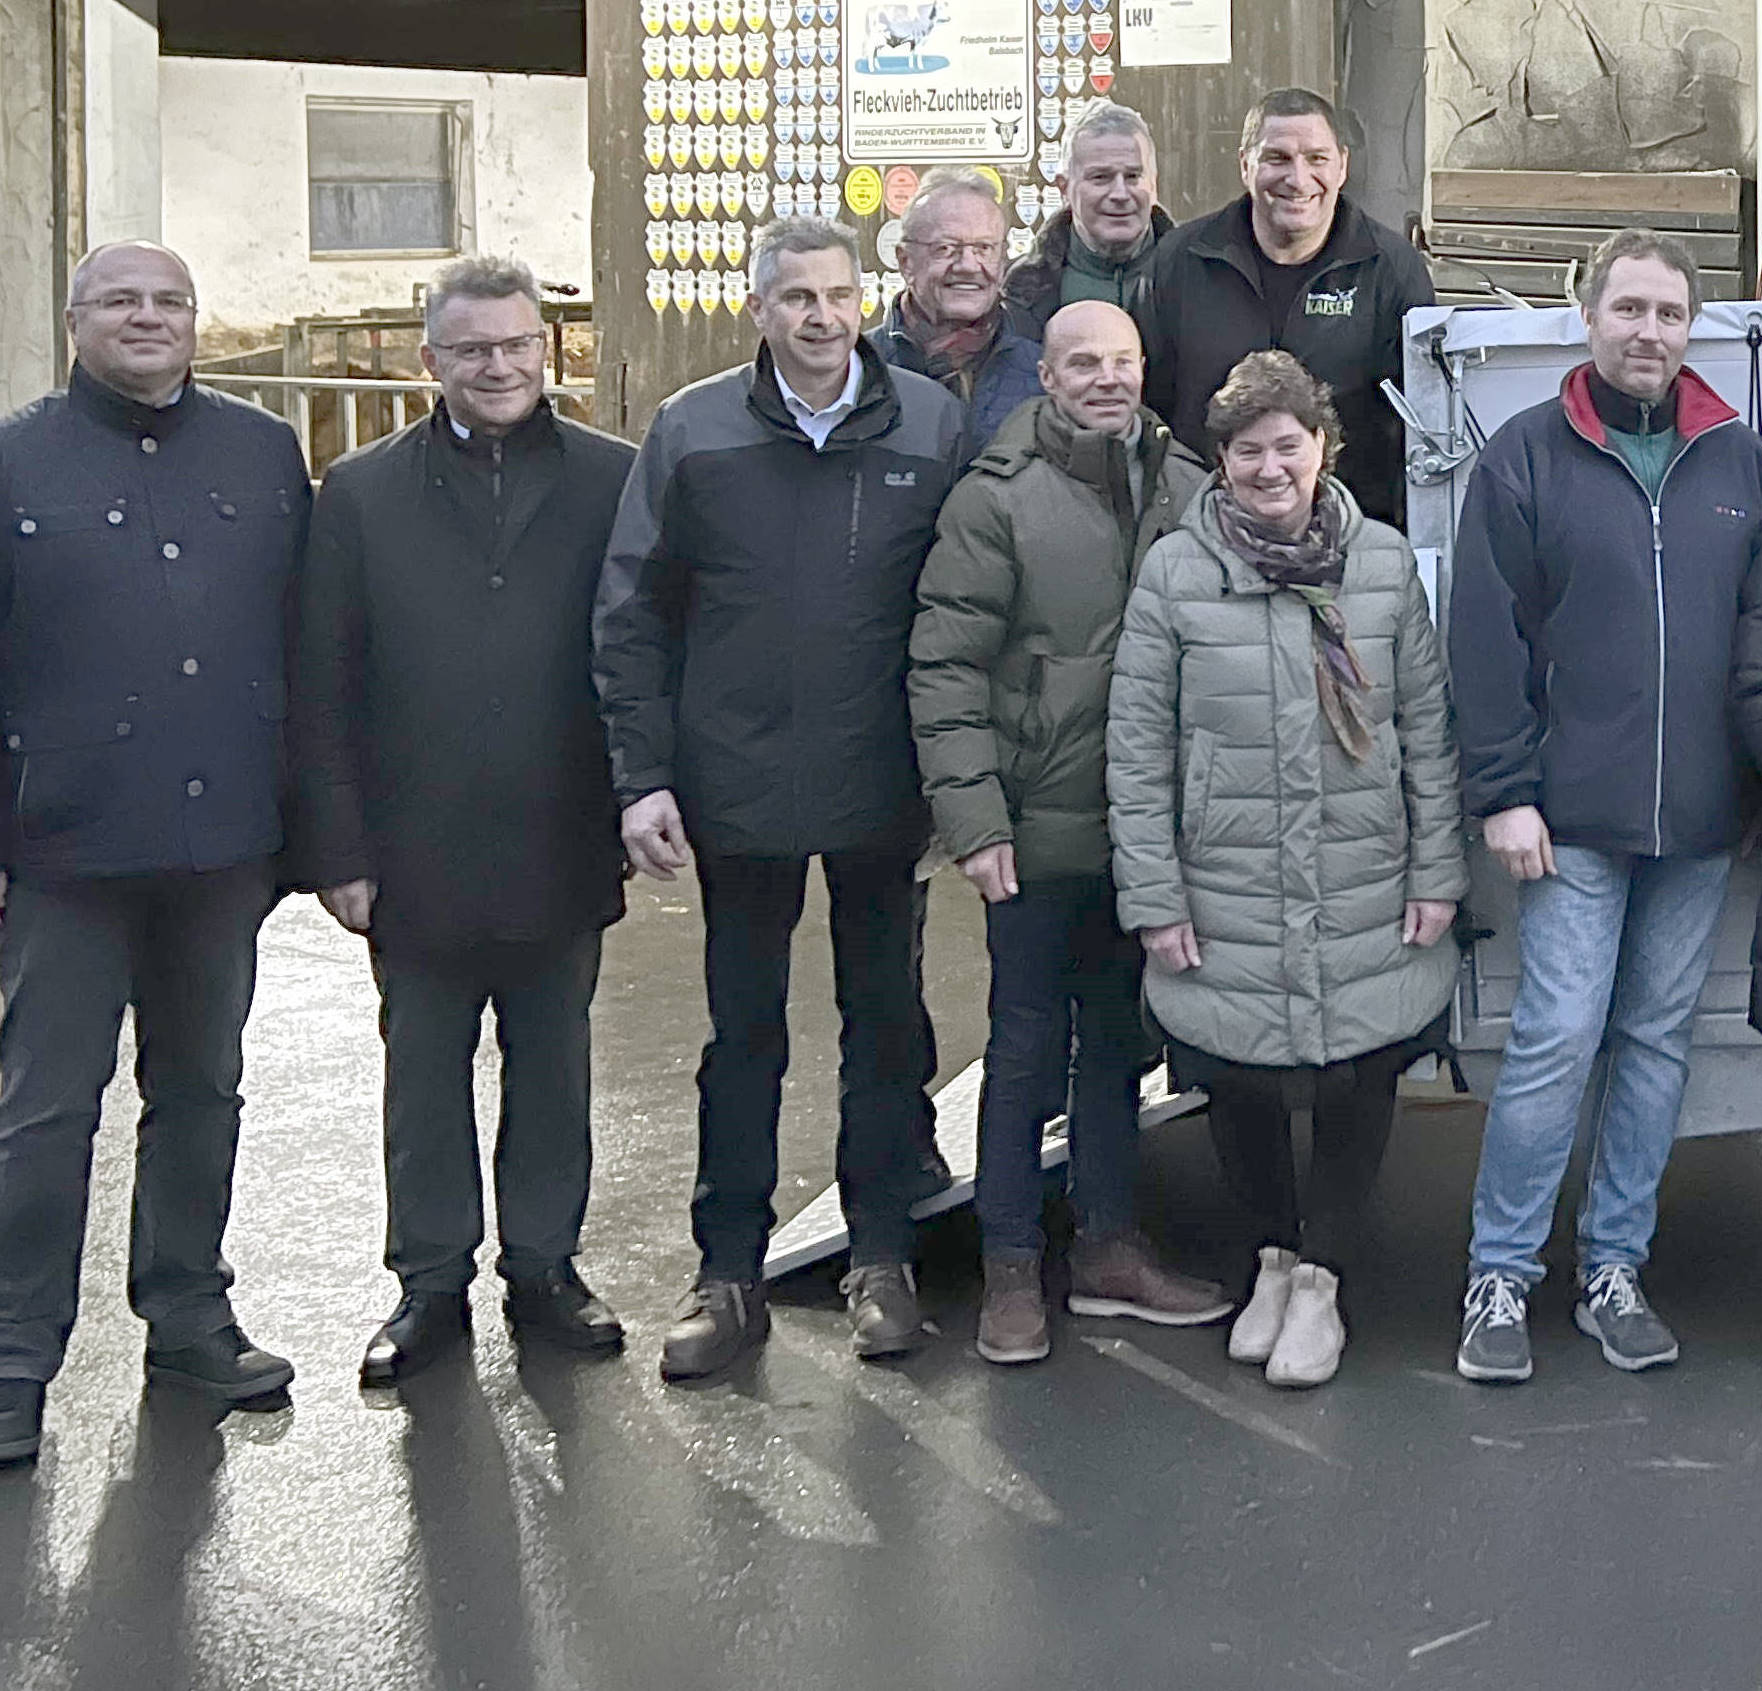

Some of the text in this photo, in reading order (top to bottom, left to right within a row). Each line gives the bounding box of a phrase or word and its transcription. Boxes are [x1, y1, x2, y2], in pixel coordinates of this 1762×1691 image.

[853, 86, 1023, 114] Fleckvieh-Zuchtbetrieb
[854, 127, 987, 137] RINDERZUCHTVERBAND IN
[1305, 299, 1354, 317] KAISER
